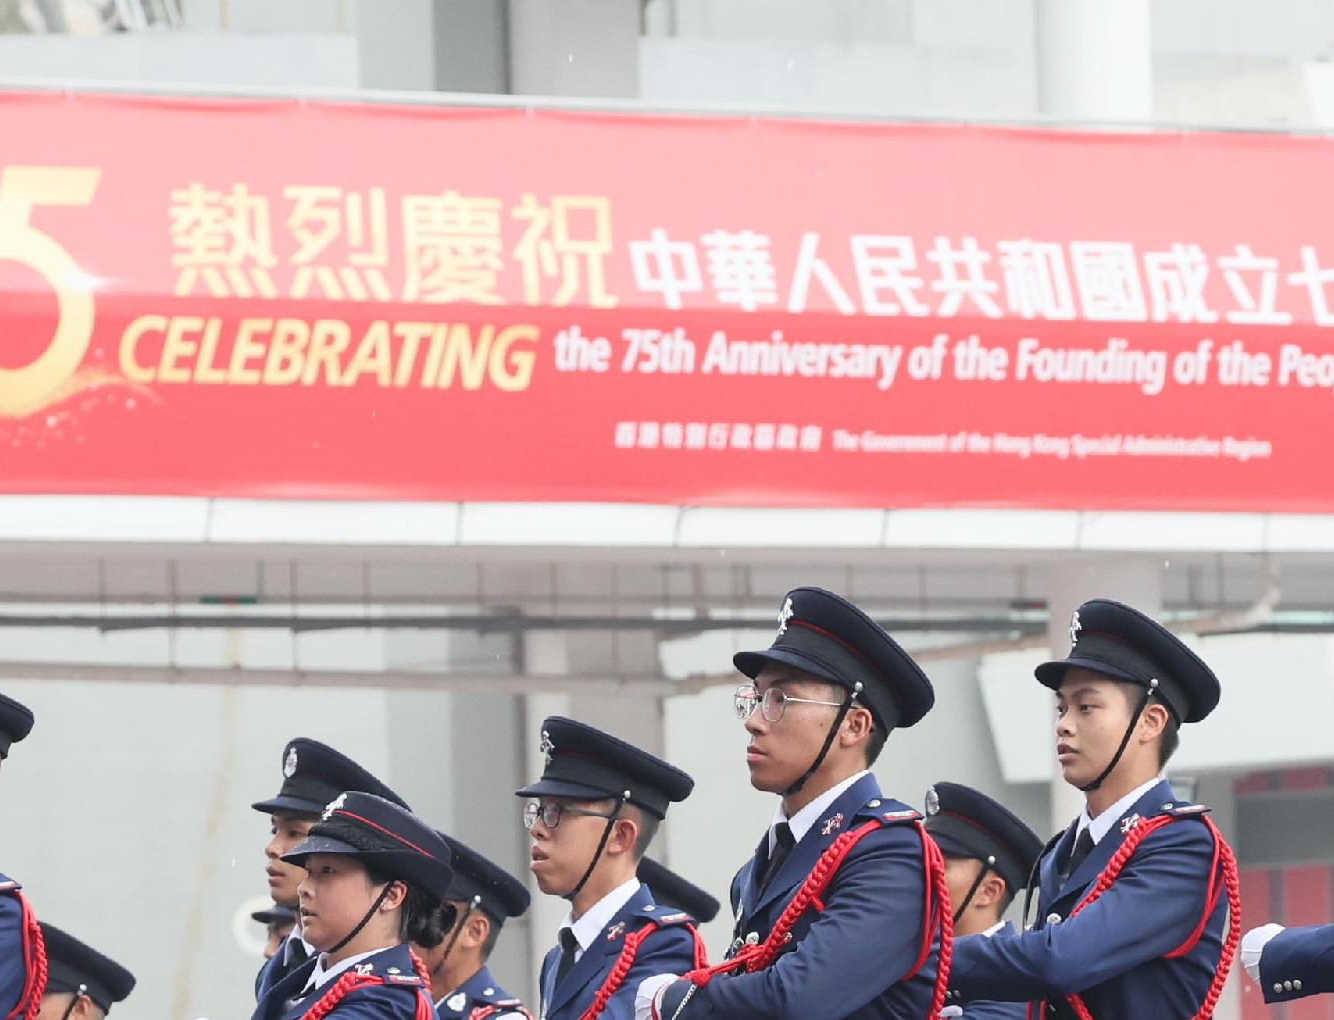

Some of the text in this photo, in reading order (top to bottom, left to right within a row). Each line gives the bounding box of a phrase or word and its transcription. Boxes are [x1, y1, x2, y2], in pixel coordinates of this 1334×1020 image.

[168, 182, 618, 308] 熱烈慶祝
[118, 314, 540, 392] CELEBRATING
[554, 325, 612, 372] the
[621, 327, 696, 374] 75th
[701, 330, 903, 390] Anniversary
[907, 333, 949, 380] of
[952, 334, 1009, 381] the
[1016, 337, 1167, 395] Founding
[1173, 339, 1214, 385] of
[1217, 340, 1272, 386] the
